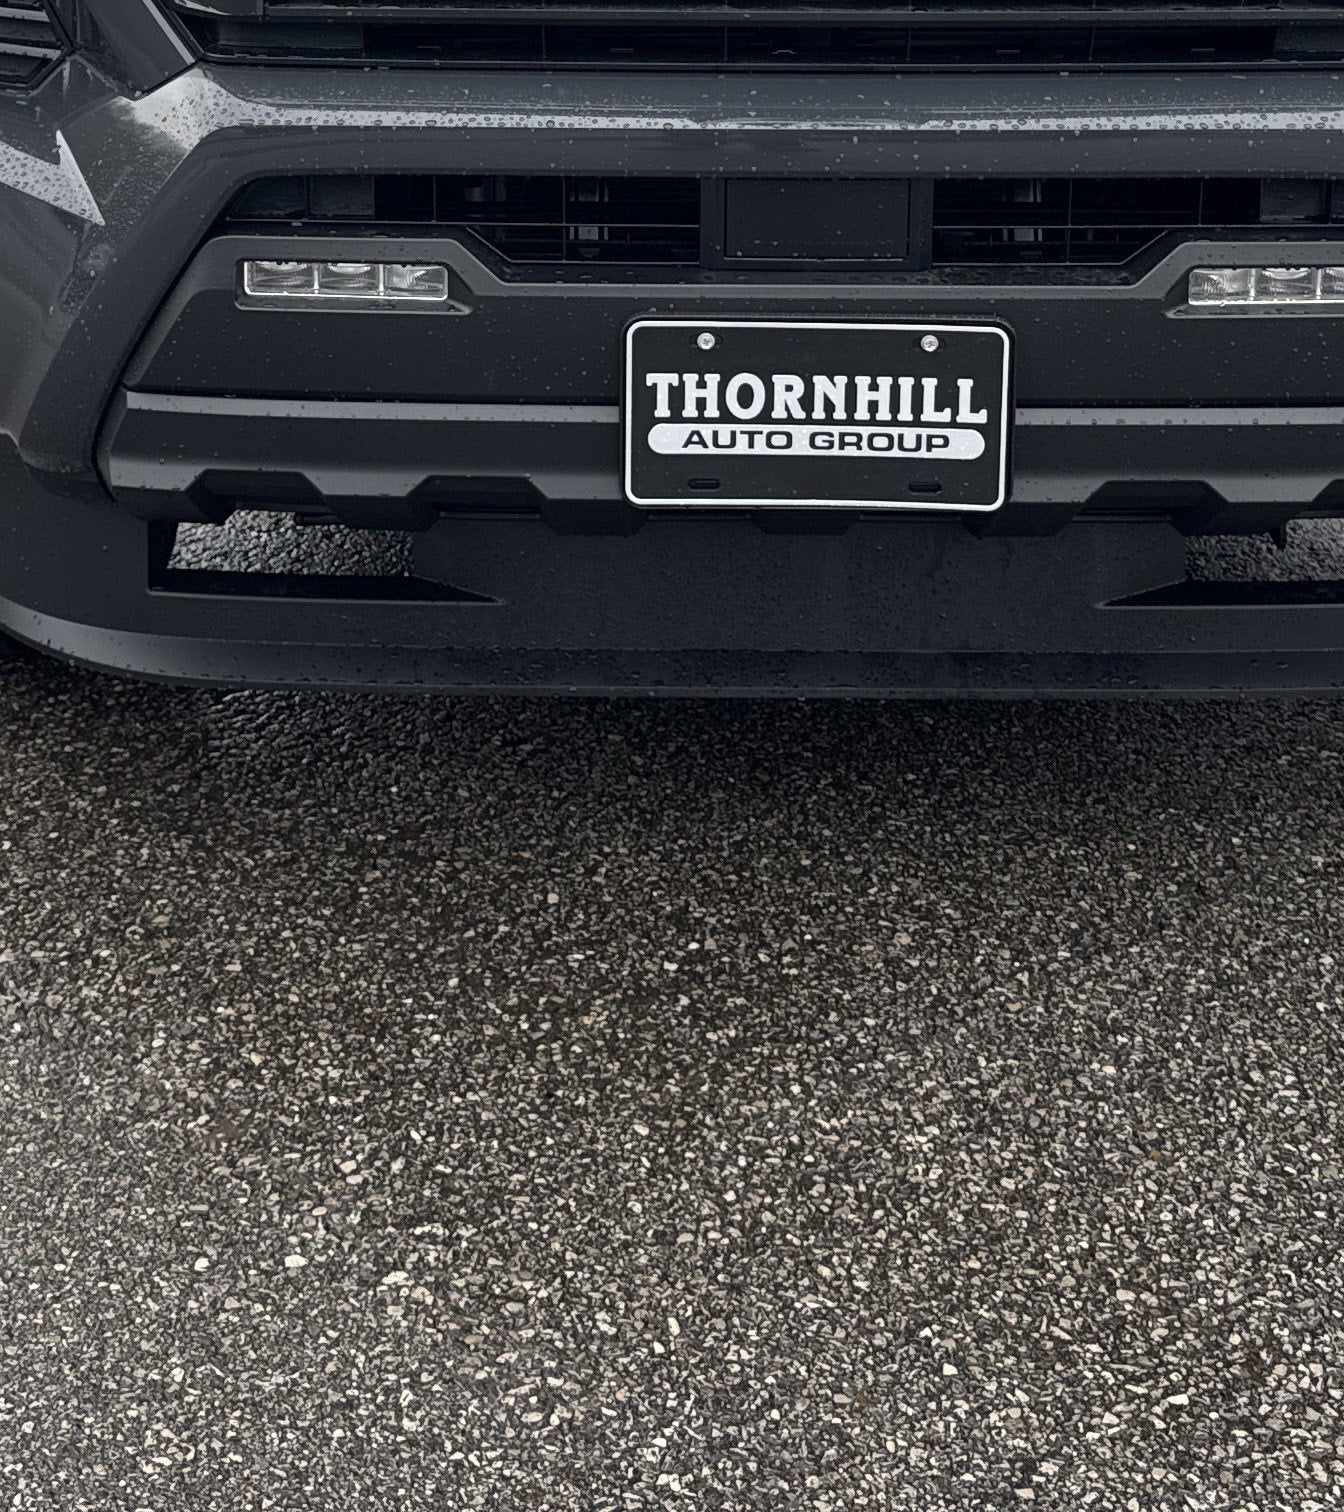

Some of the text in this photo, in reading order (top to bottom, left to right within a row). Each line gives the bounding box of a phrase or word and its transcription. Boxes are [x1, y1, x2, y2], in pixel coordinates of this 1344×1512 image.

[646, 372, 987, 424] THORNHILL
[682, 430, 950, 453] AUTO GROUP
